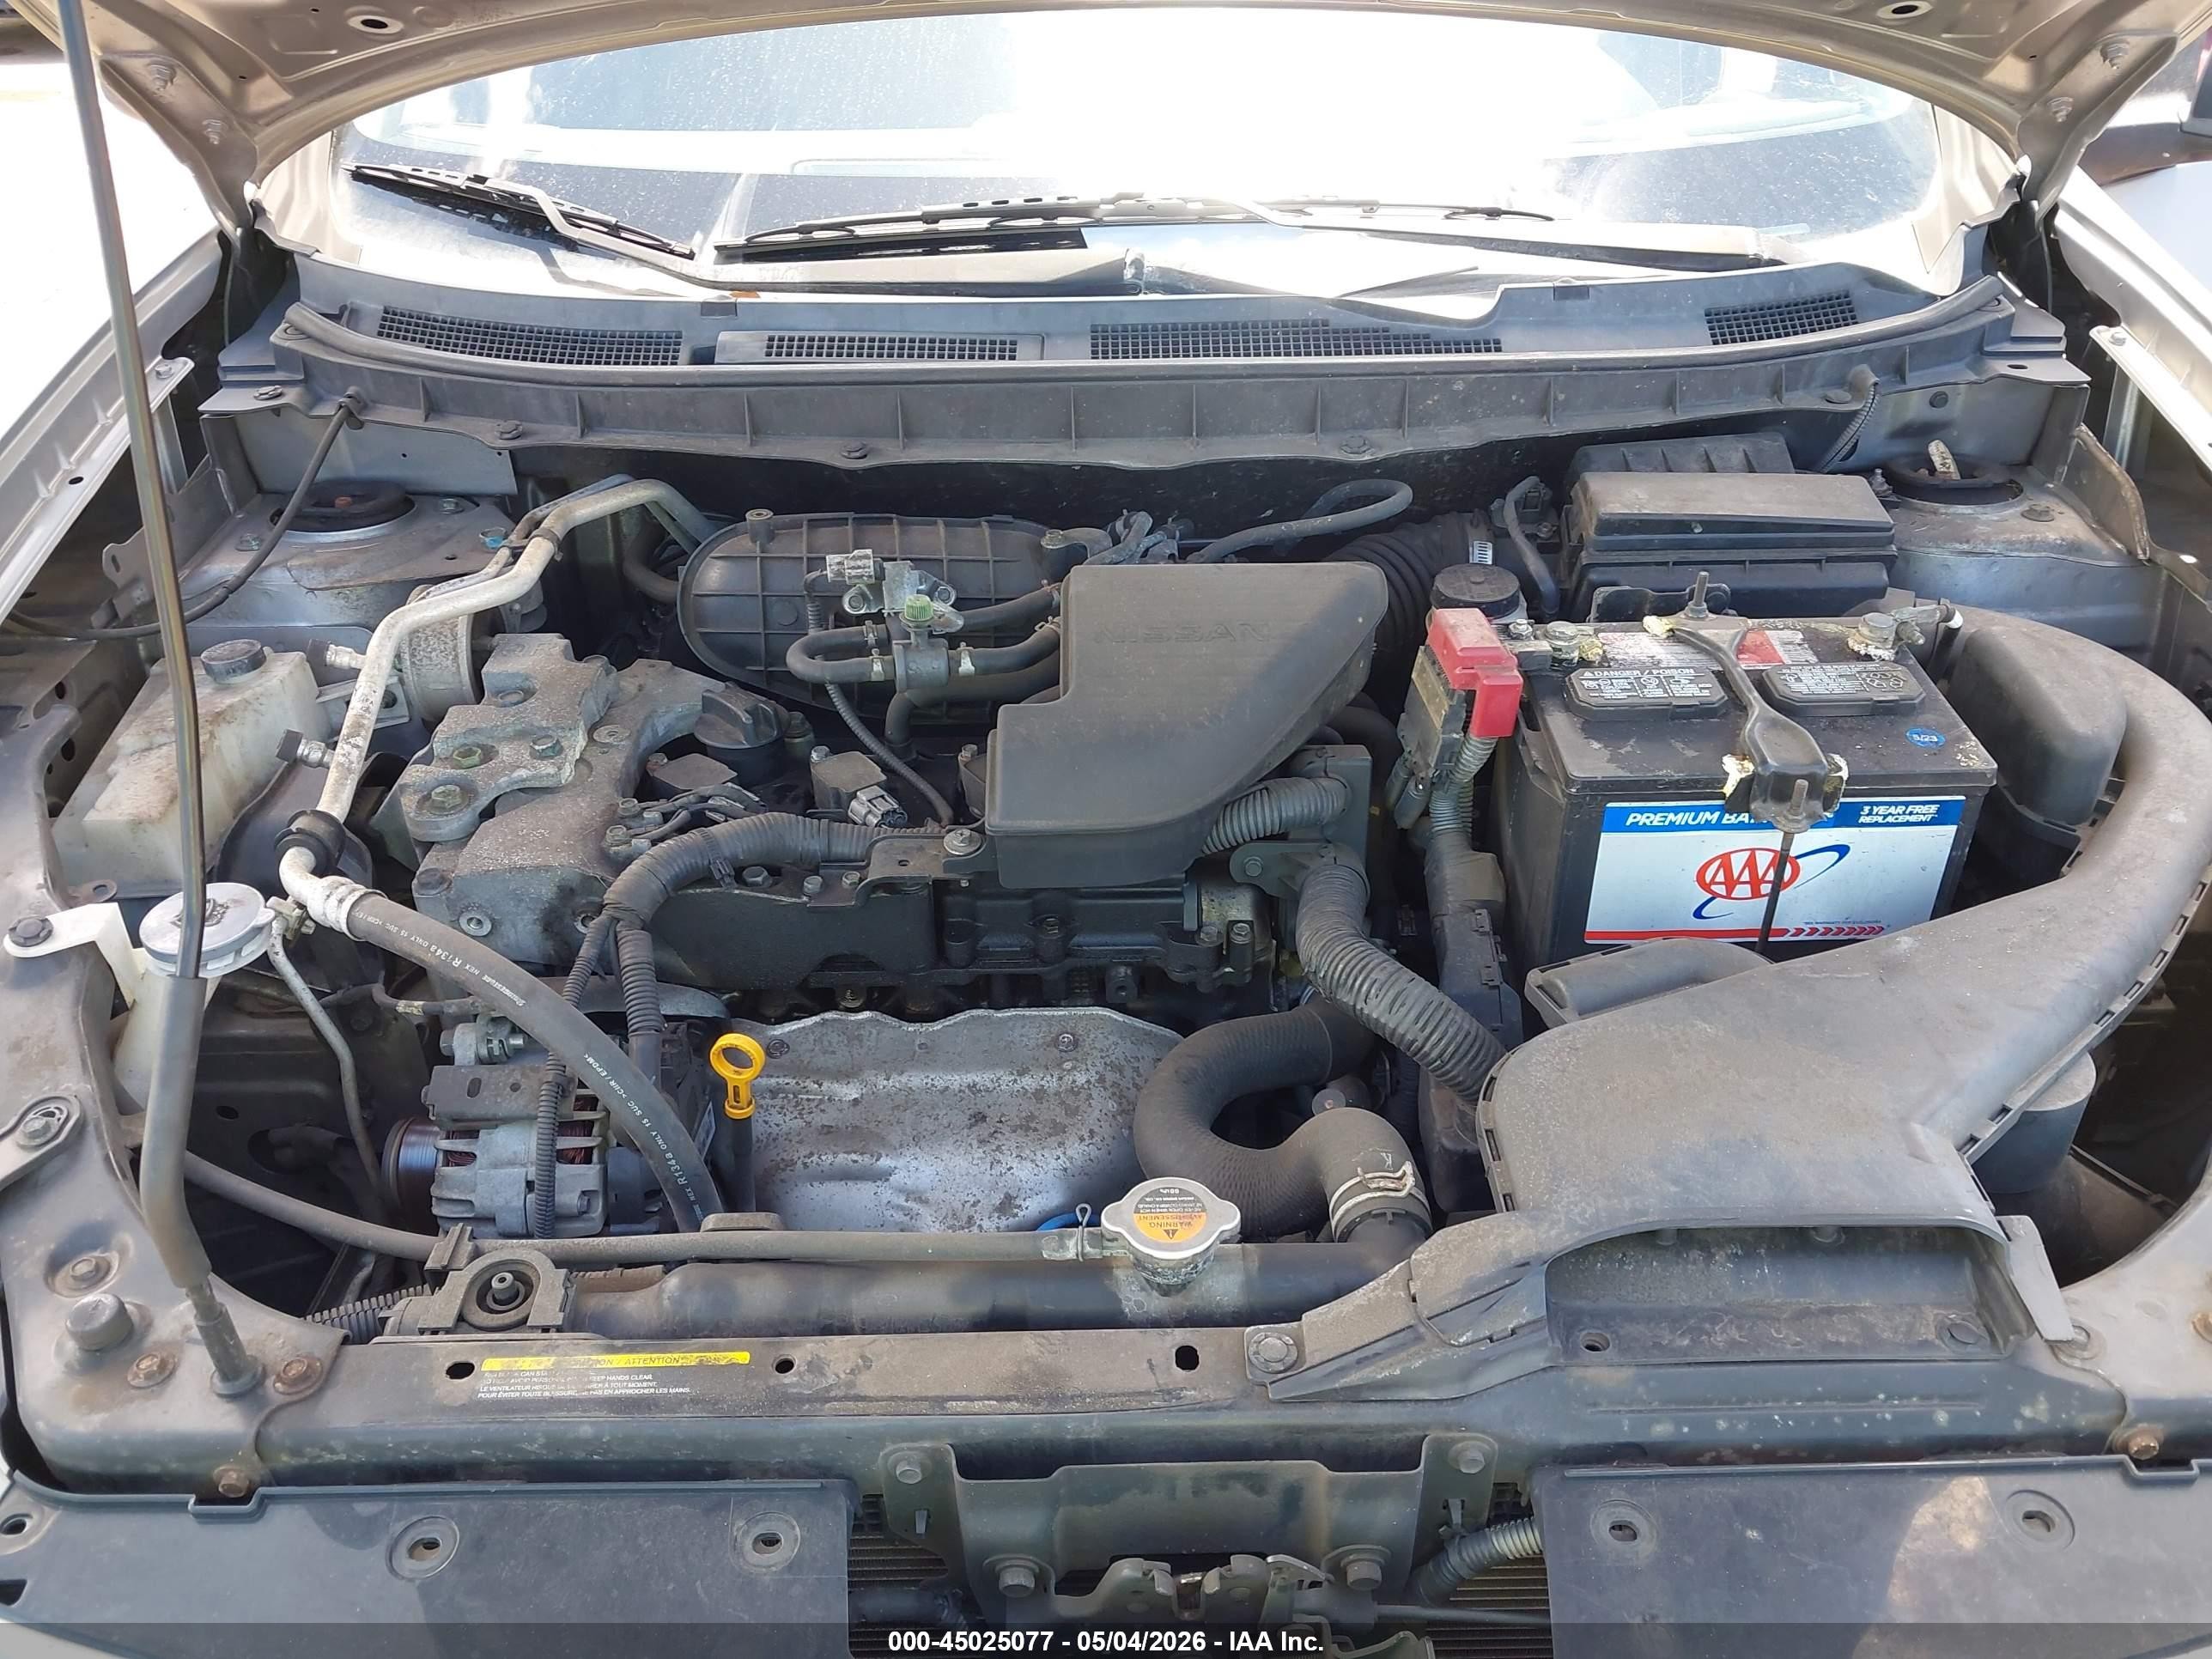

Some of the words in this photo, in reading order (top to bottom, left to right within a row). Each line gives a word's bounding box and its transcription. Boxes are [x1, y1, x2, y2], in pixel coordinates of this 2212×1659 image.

[1626, 811, 1719, 826] PREMIUM
[1860, 805, 1871, 815] 3
[1872, 805, 1905, 815] YEAR
[1905, 804, 1940, 814] FREE
[429, 945, 462, 968] R134a
[627, 1100, 644, 1117] SUC
[650, 1130, 668, 1152] ONLY
[665, 1152, 689, 1186] R134a
